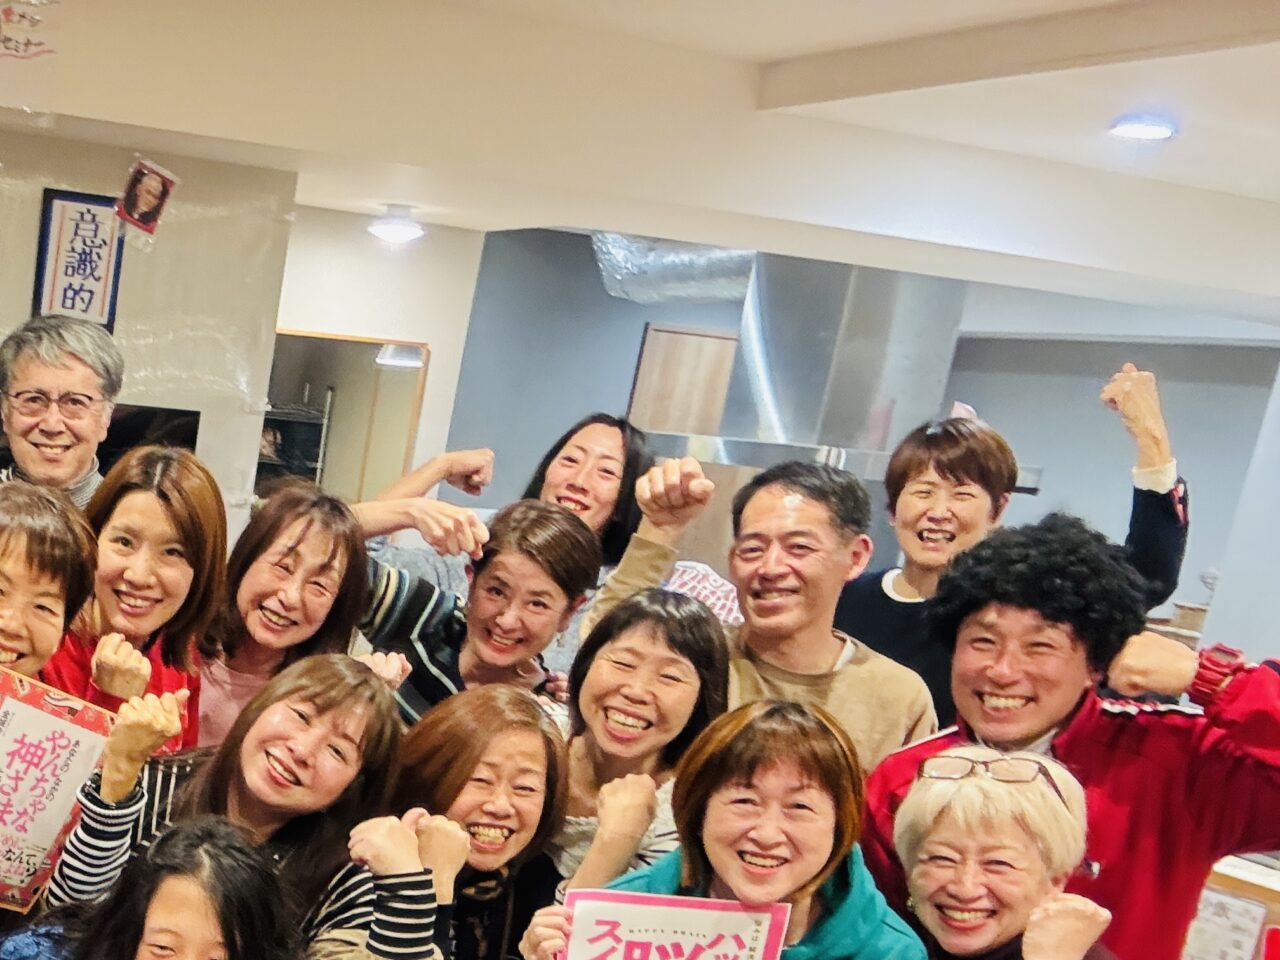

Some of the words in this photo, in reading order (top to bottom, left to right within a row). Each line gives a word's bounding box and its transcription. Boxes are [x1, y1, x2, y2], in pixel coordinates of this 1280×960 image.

[61, 208, 107, 312] 意識的
[11, 729, 71, 833] やんちゃな
